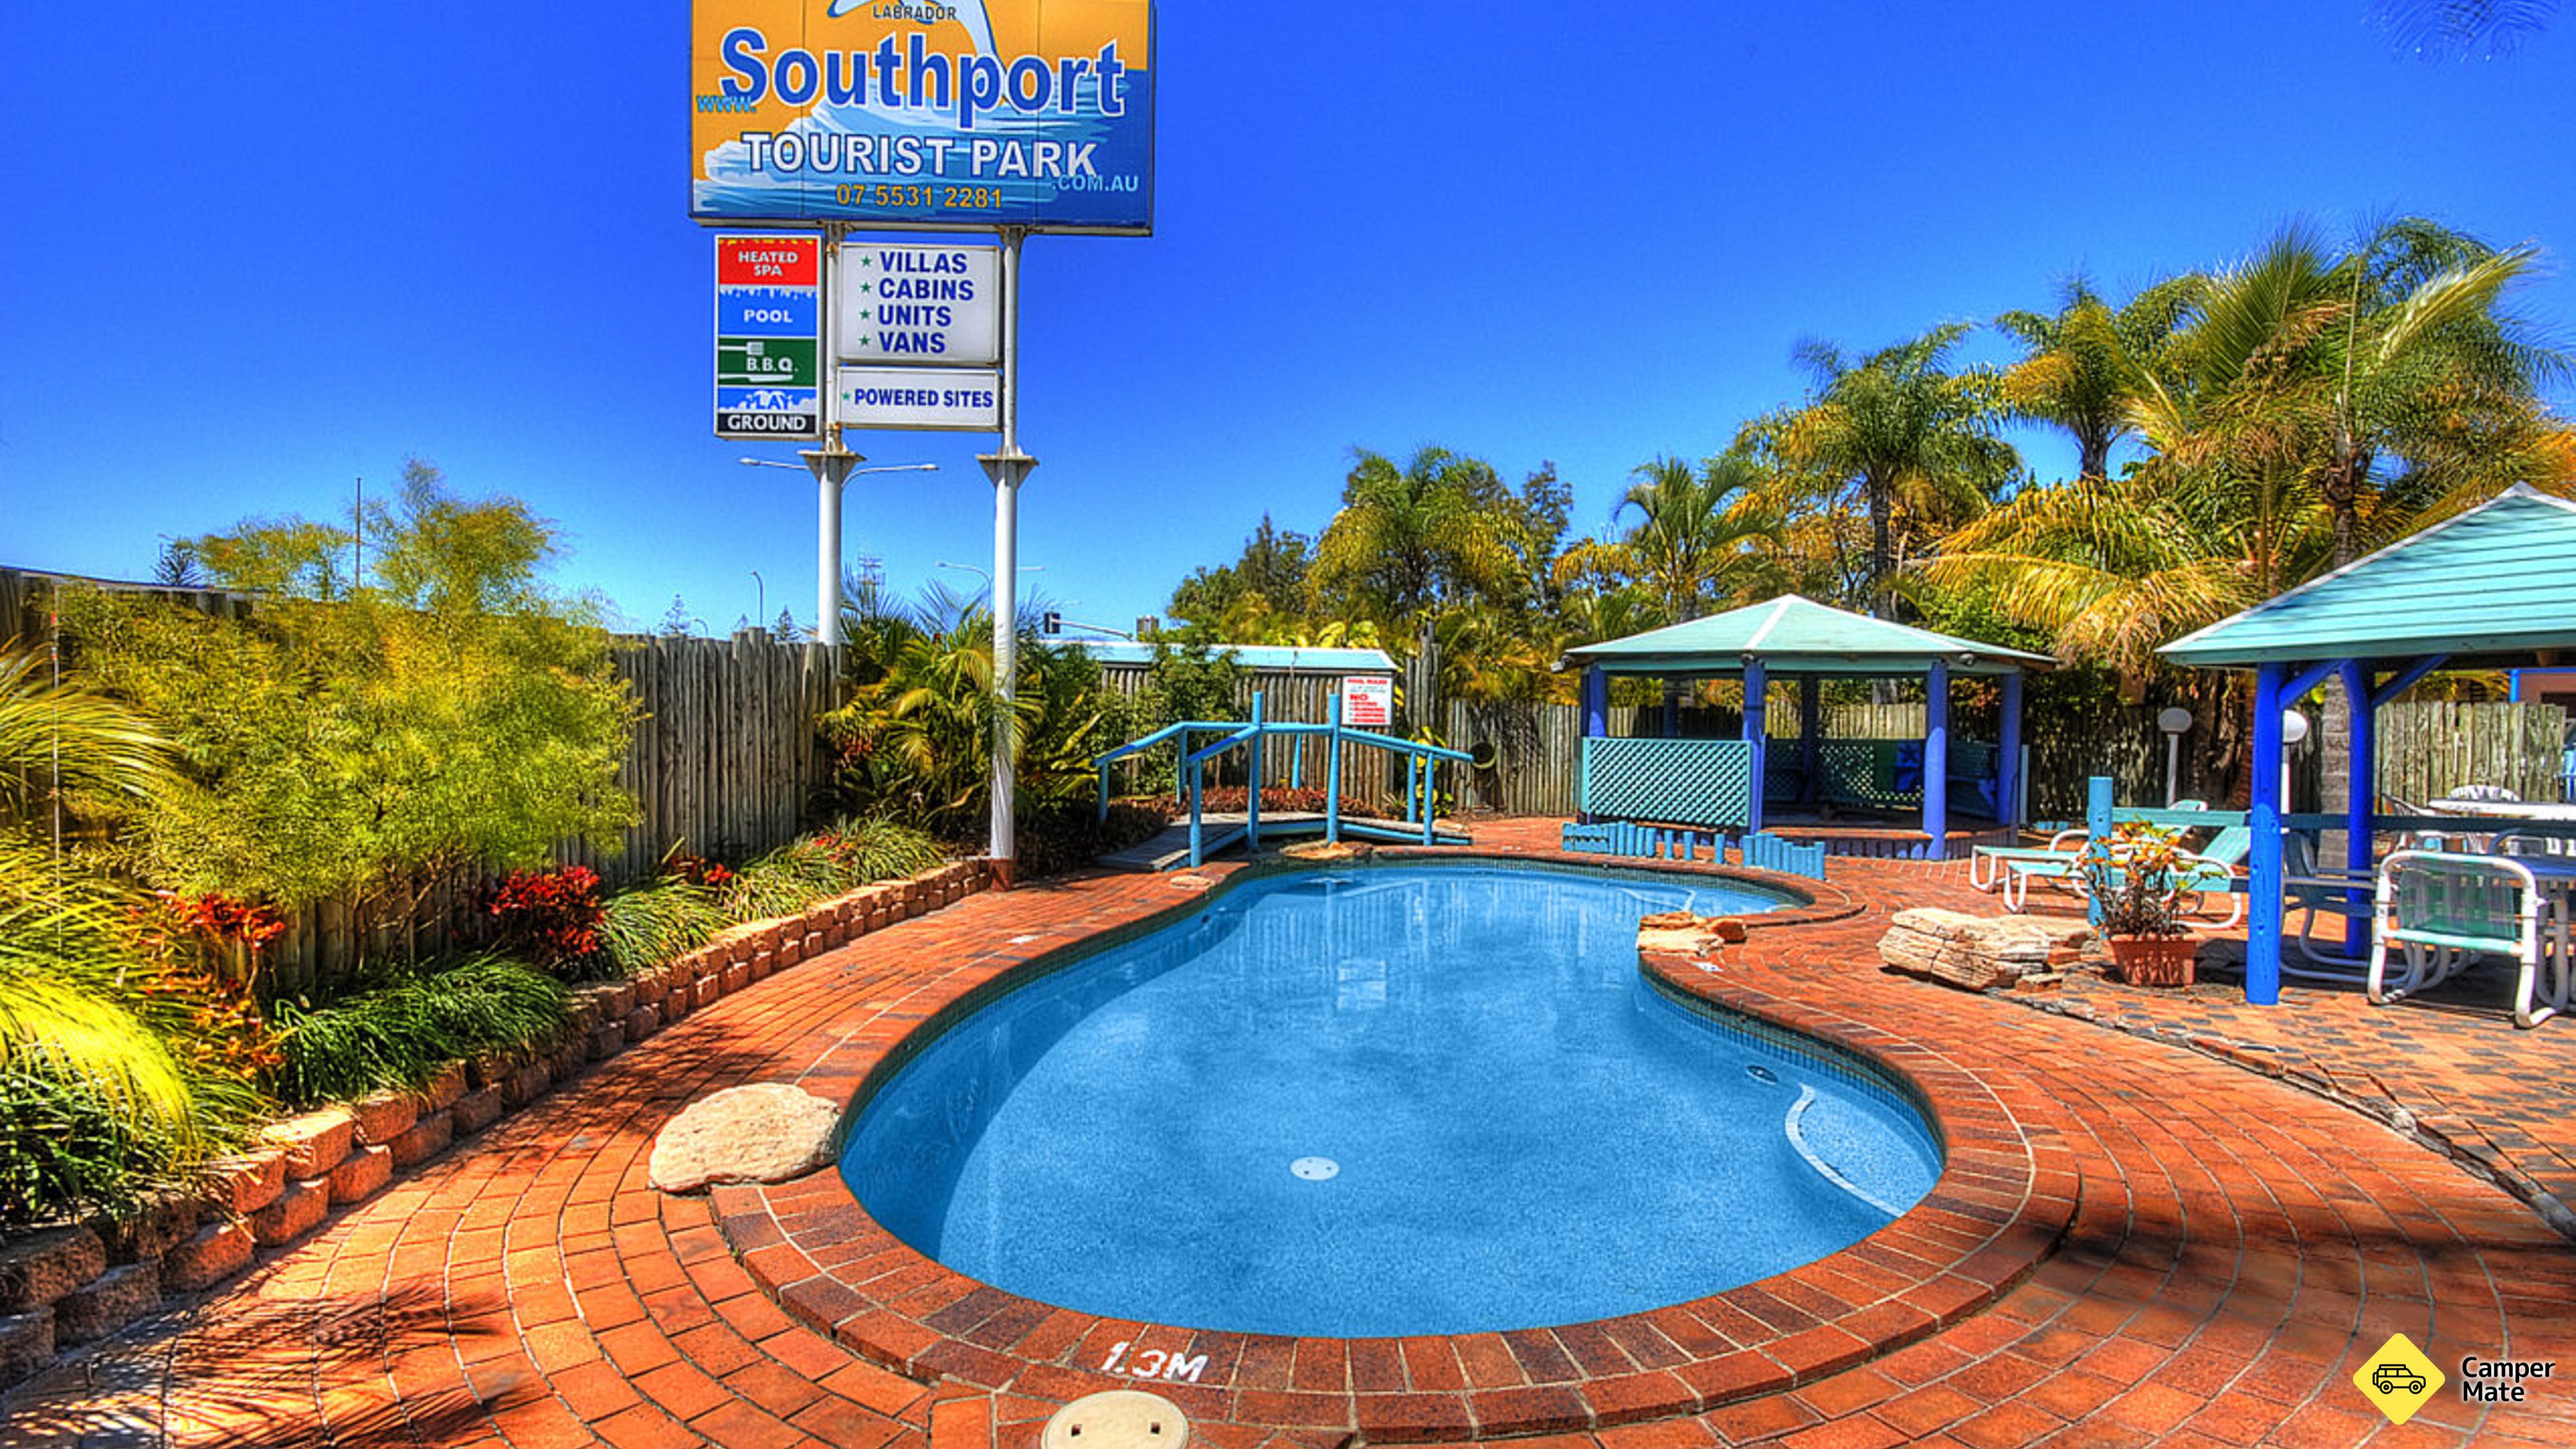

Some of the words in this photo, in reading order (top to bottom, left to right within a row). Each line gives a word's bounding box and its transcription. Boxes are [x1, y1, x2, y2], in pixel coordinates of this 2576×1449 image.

[873, 4, 957, 20] LABRADOR
[719, 27, 1125, 129] Southport
[696, 95, 757, 113] www.
[741, 132, 954, 175] TOURIST
[970, 138, 1097, 179] PARK
[1052, 175, 1139, 192] .COM.AU
[837, 184, 864, 205] 07
[875, 186, 933, 207] 5531
[944, 187, 1002, 208] 2281
[738, 250, 799, 263] HEATED
[880, 251, 967, 274] VILLAS
[754, 265, 783, 276] SPA
[878, 278, 974, 301] CABINS
[744, 309, 793, 323] POOL
[878, 305, 951, 327] UNITS
[878, 332, 945, 354] VANS
[746, 357, 799, 373] B.B.Q.
[855, 388, 938, 406] POWERED
[944, 390, 994, 408] SITES
[728, 415, 806, 430] GROUND
[1102, 1341, 1209, 1383] 1.3M
